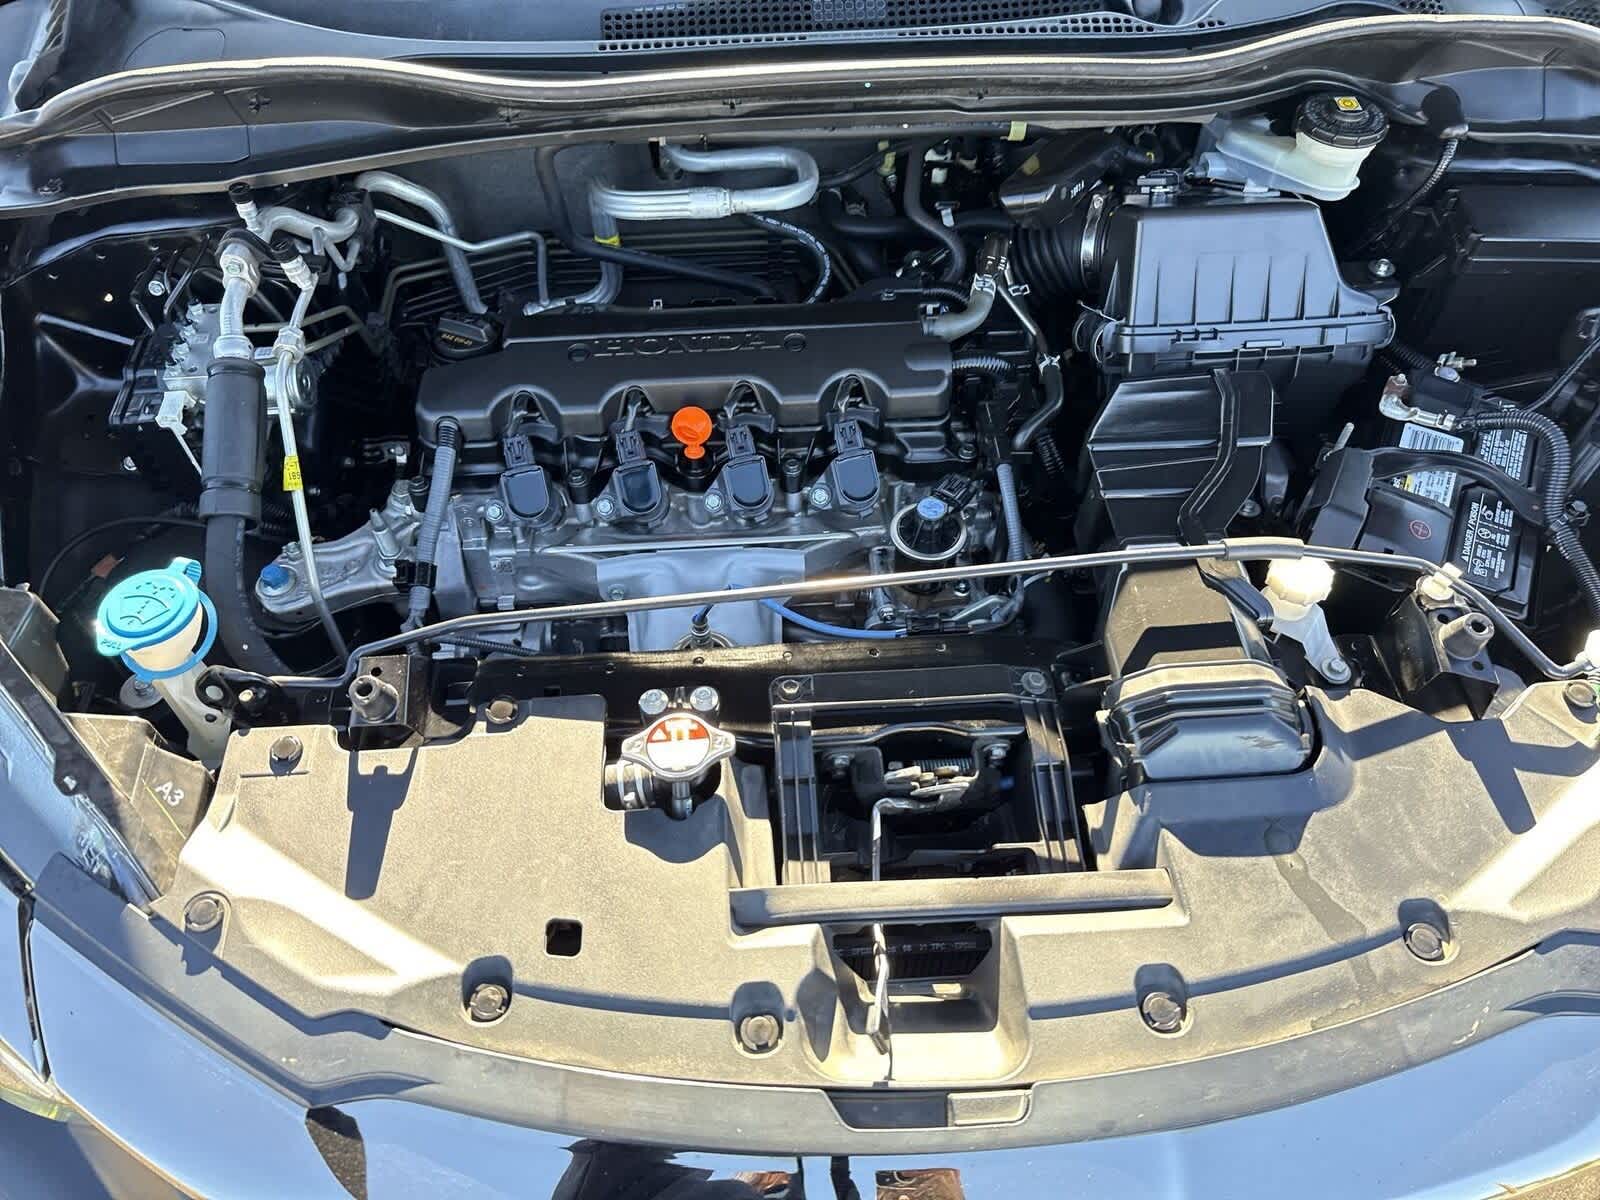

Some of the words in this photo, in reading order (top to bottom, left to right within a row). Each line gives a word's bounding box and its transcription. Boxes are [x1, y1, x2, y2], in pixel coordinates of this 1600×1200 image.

[594, 334, 781, 357] HONDA
[1461, 529, 1475, 556] DANGER
[1468, 502, 1480, 525] POISON
[155, 781, 184, 806] A3
